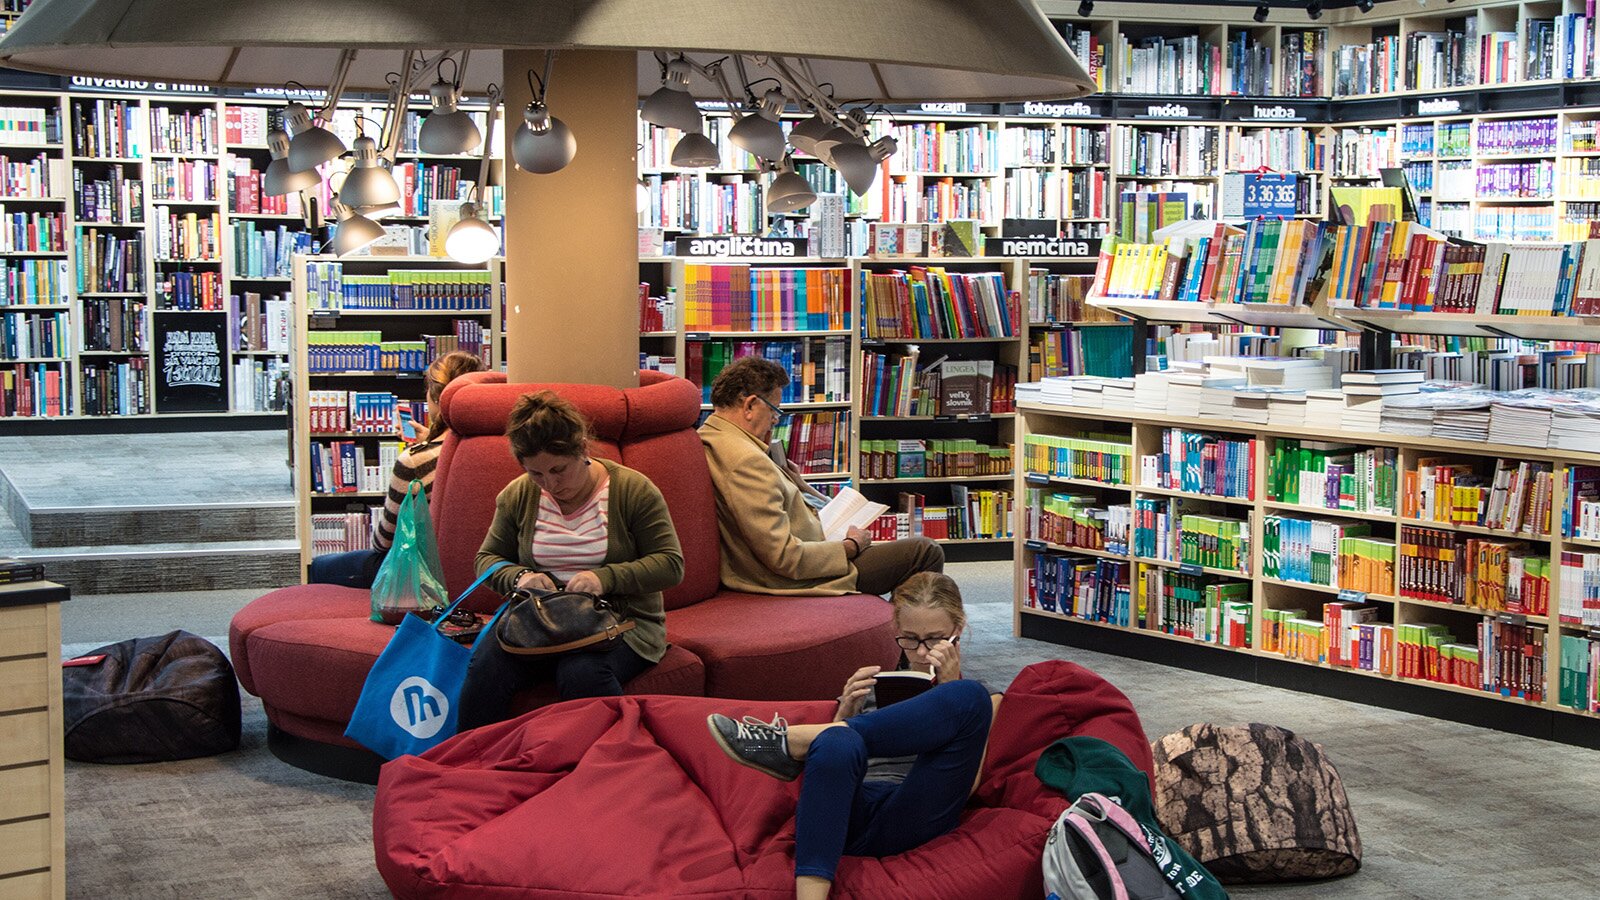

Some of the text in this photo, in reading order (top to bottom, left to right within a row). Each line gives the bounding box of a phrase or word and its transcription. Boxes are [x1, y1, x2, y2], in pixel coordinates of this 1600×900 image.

[1090, 50, 1098, 79] ARAKI
[1023, 101, 1092, 117] fotografia
[1148, 103, 1189, 117] móda
[1254, 105, 1296, 118] hudba
[1248, 184, 1296, 202] 3 36 365
[690, 236, 795, 257] angličtina
[1002, 237, 1089, 256] nemčina
